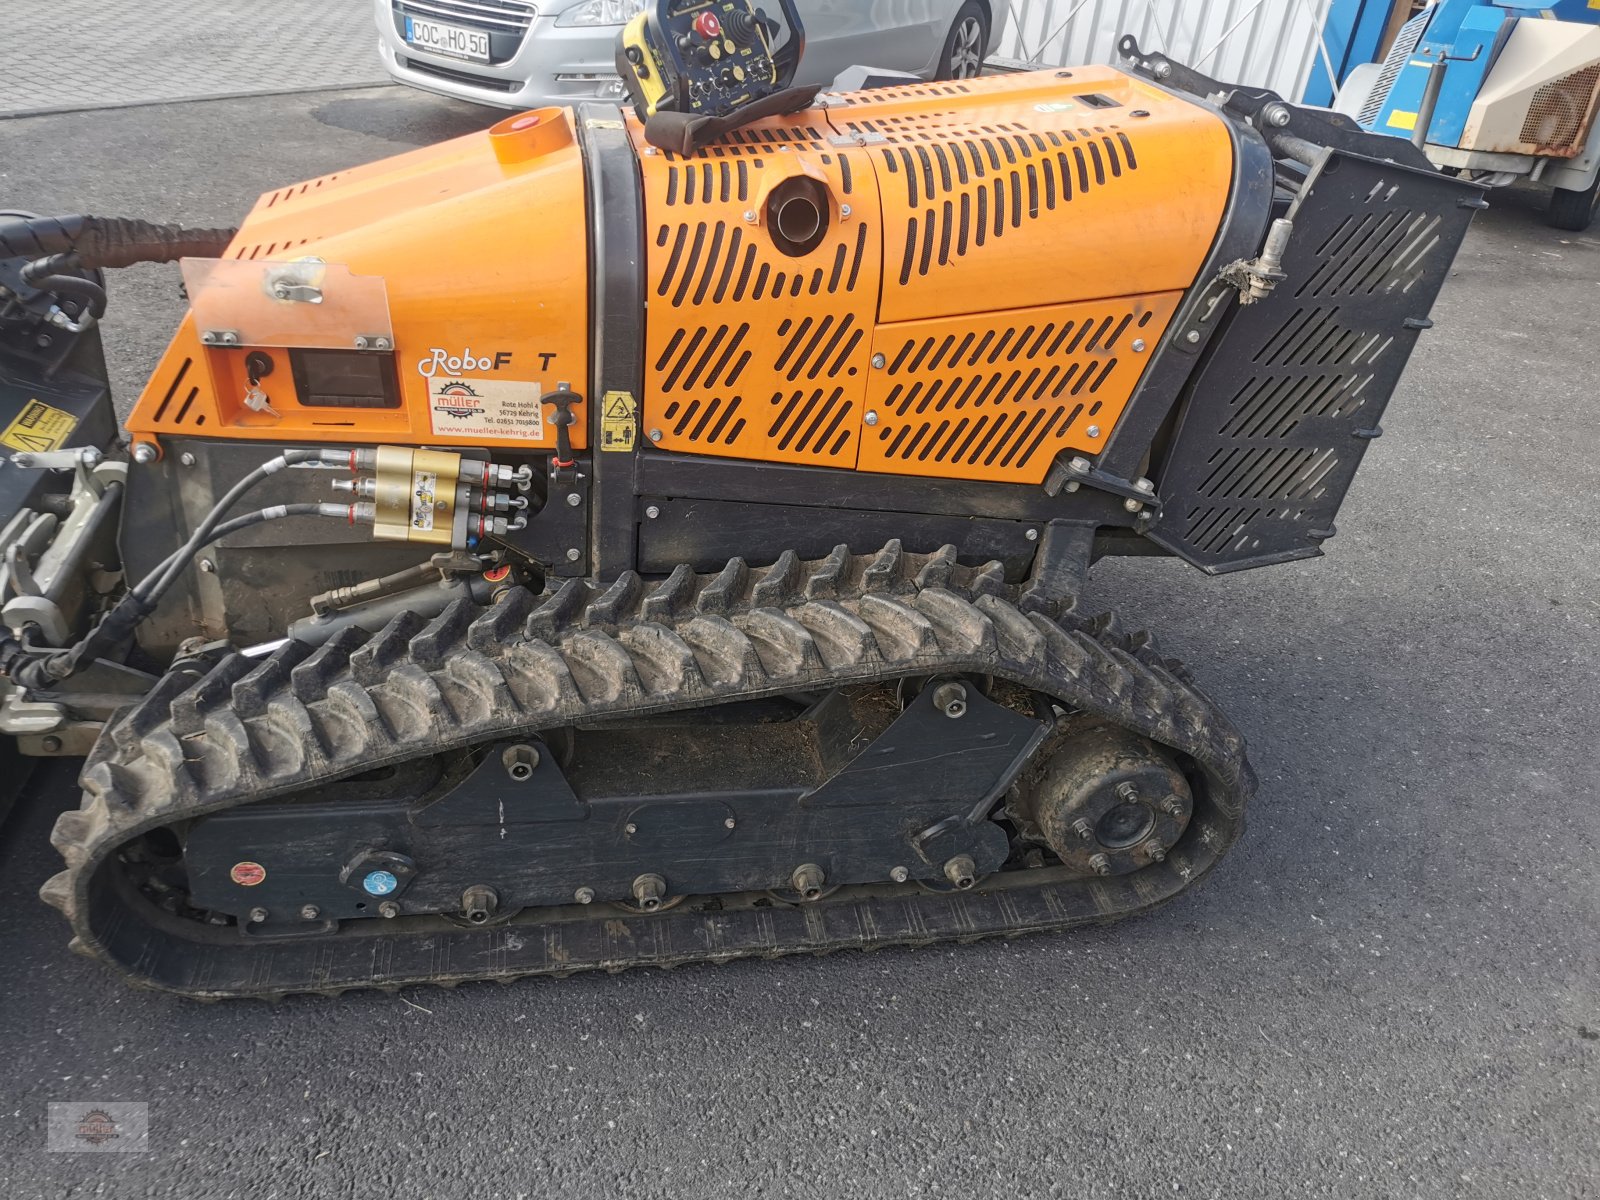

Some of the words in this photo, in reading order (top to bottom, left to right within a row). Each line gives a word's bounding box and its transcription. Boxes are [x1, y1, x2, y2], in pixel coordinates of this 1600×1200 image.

[414, 22, 439, 44] COC
[448, 29, 466, 51] HO
[437, 396, 480, 407] müller
[519, 410, 539, 418] Kehrig
[438, 426, 540, 438] www.mueller-kehrig.de
